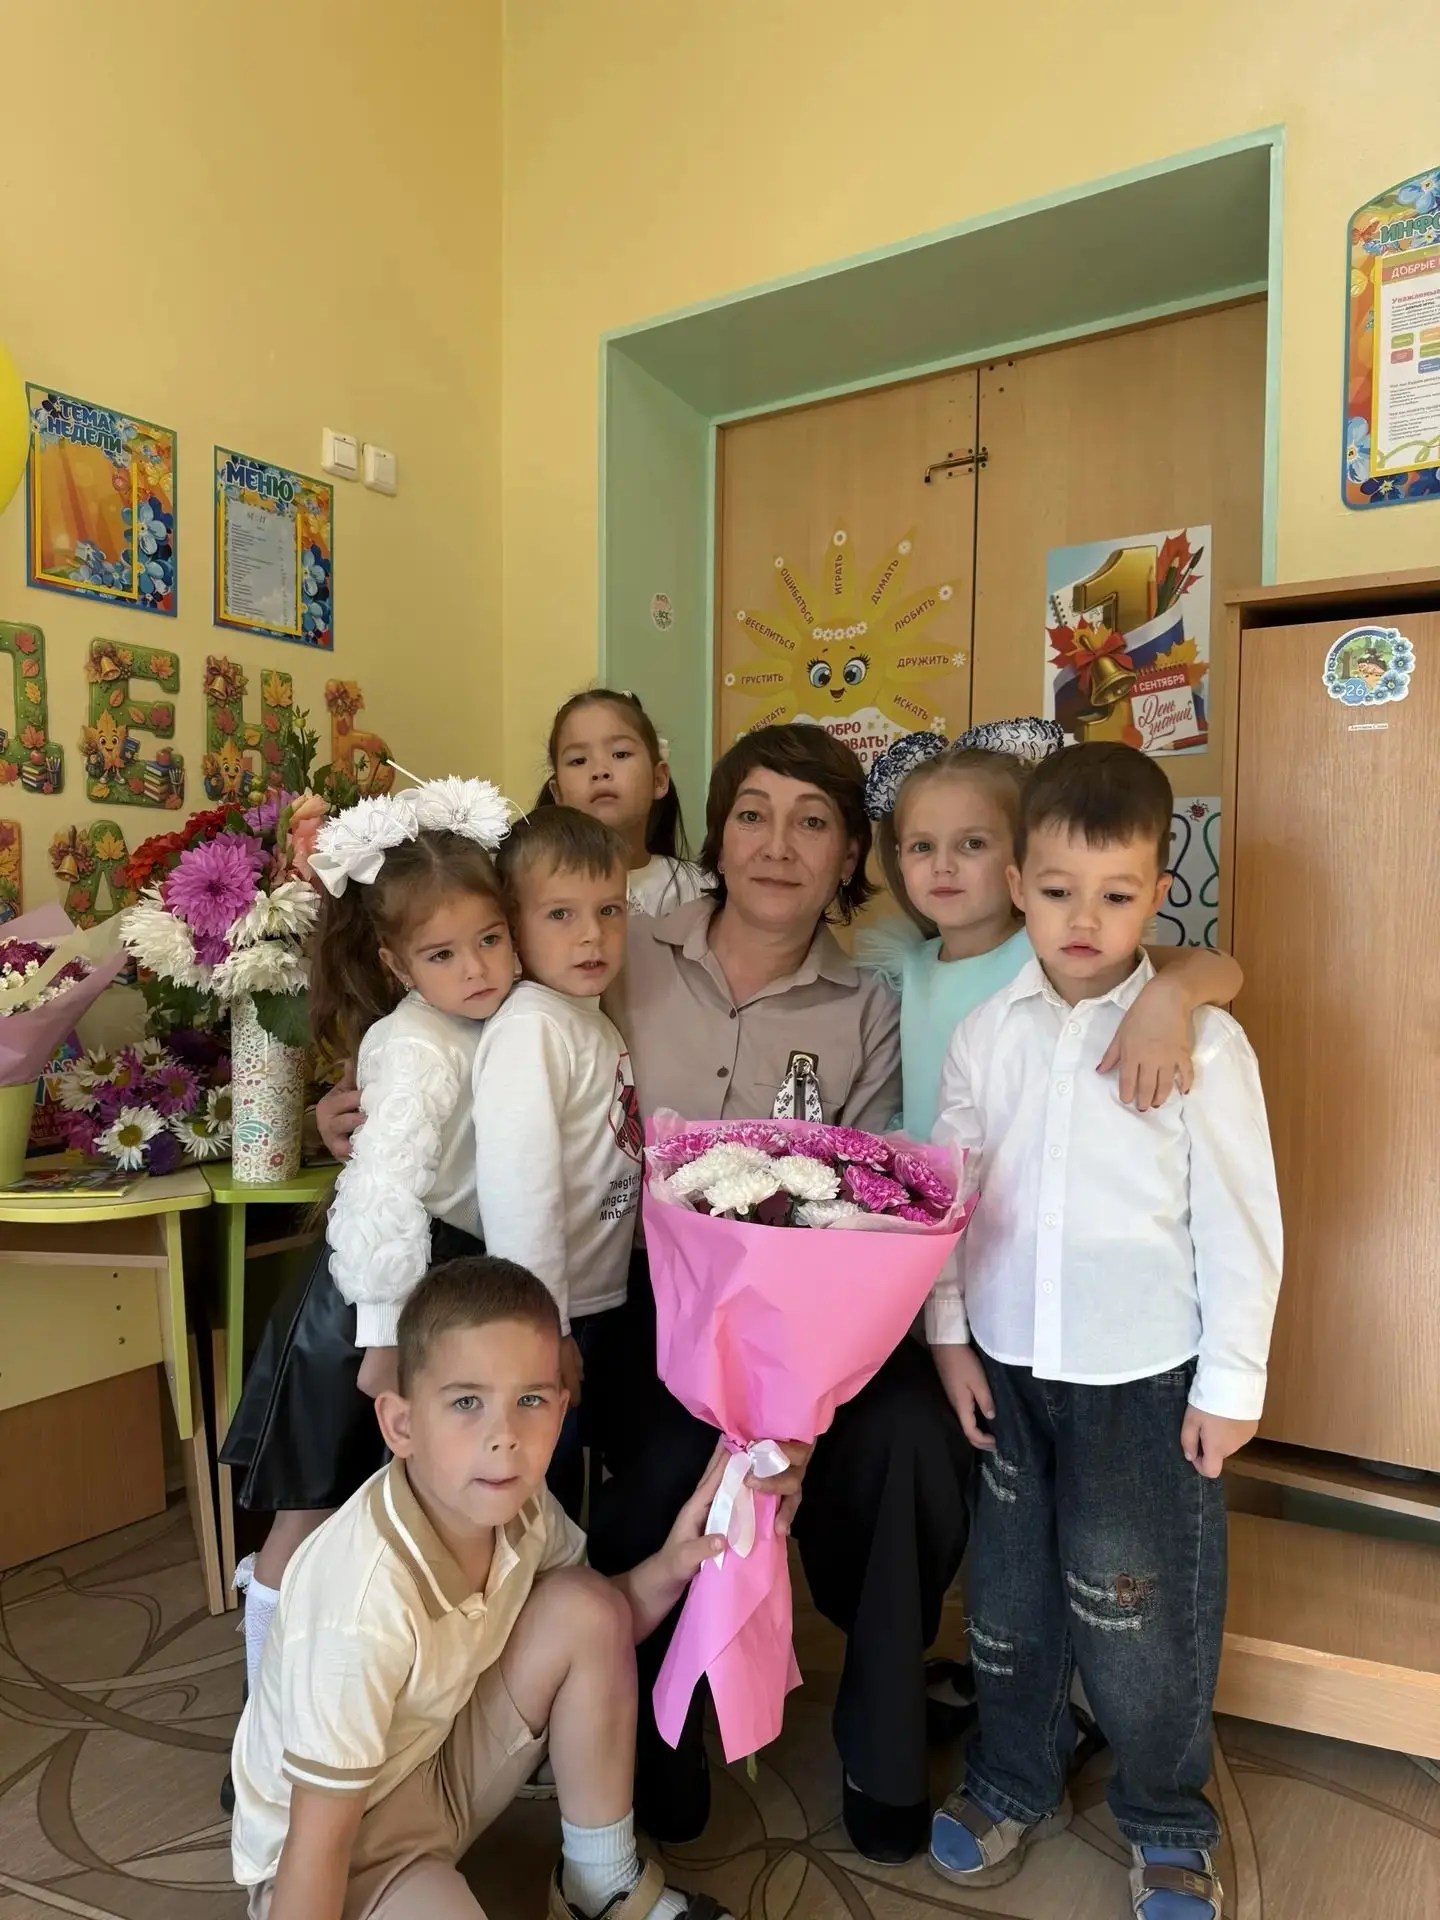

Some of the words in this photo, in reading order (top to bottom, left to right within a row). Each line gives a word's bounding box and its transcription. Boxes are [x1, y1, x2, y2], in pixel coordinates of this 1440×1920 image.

[1391, 259, 1436, 279] ДОБРЫЕ
[59, 400, 112, 433] ТЕМА
[47, 415, 123, 454] НЕДЕЛИ
[225, 461, 294, 503] МЕНЮ
[834, 554, 844, 596] ИГРАТЬ
[871, 558, 899, 605] ДУМАТЬ
[780, 567, 815, 625] ОШИБАТЬСЯ
[894, 597, 936, 632] ЛЮБИТЬ
[744, 616, 796, 652] ВЕСЕЛИТЬСЯ
[741, 672, 784, 685] ГРУСТИТЬ
[896, 655, 949, 669] ДРУЖИТЬ
[1140, 673, 1186, 692] СЕНТЯБРЯ
[1346, 684, 1365, 697] 26
[893, 694, 929, 721] ИСКАТЬ
[1137, 694, 1176, 728] День
[1143, 701, 1193, 748] знаний
[821, 721, 862, 736] ОБРО
